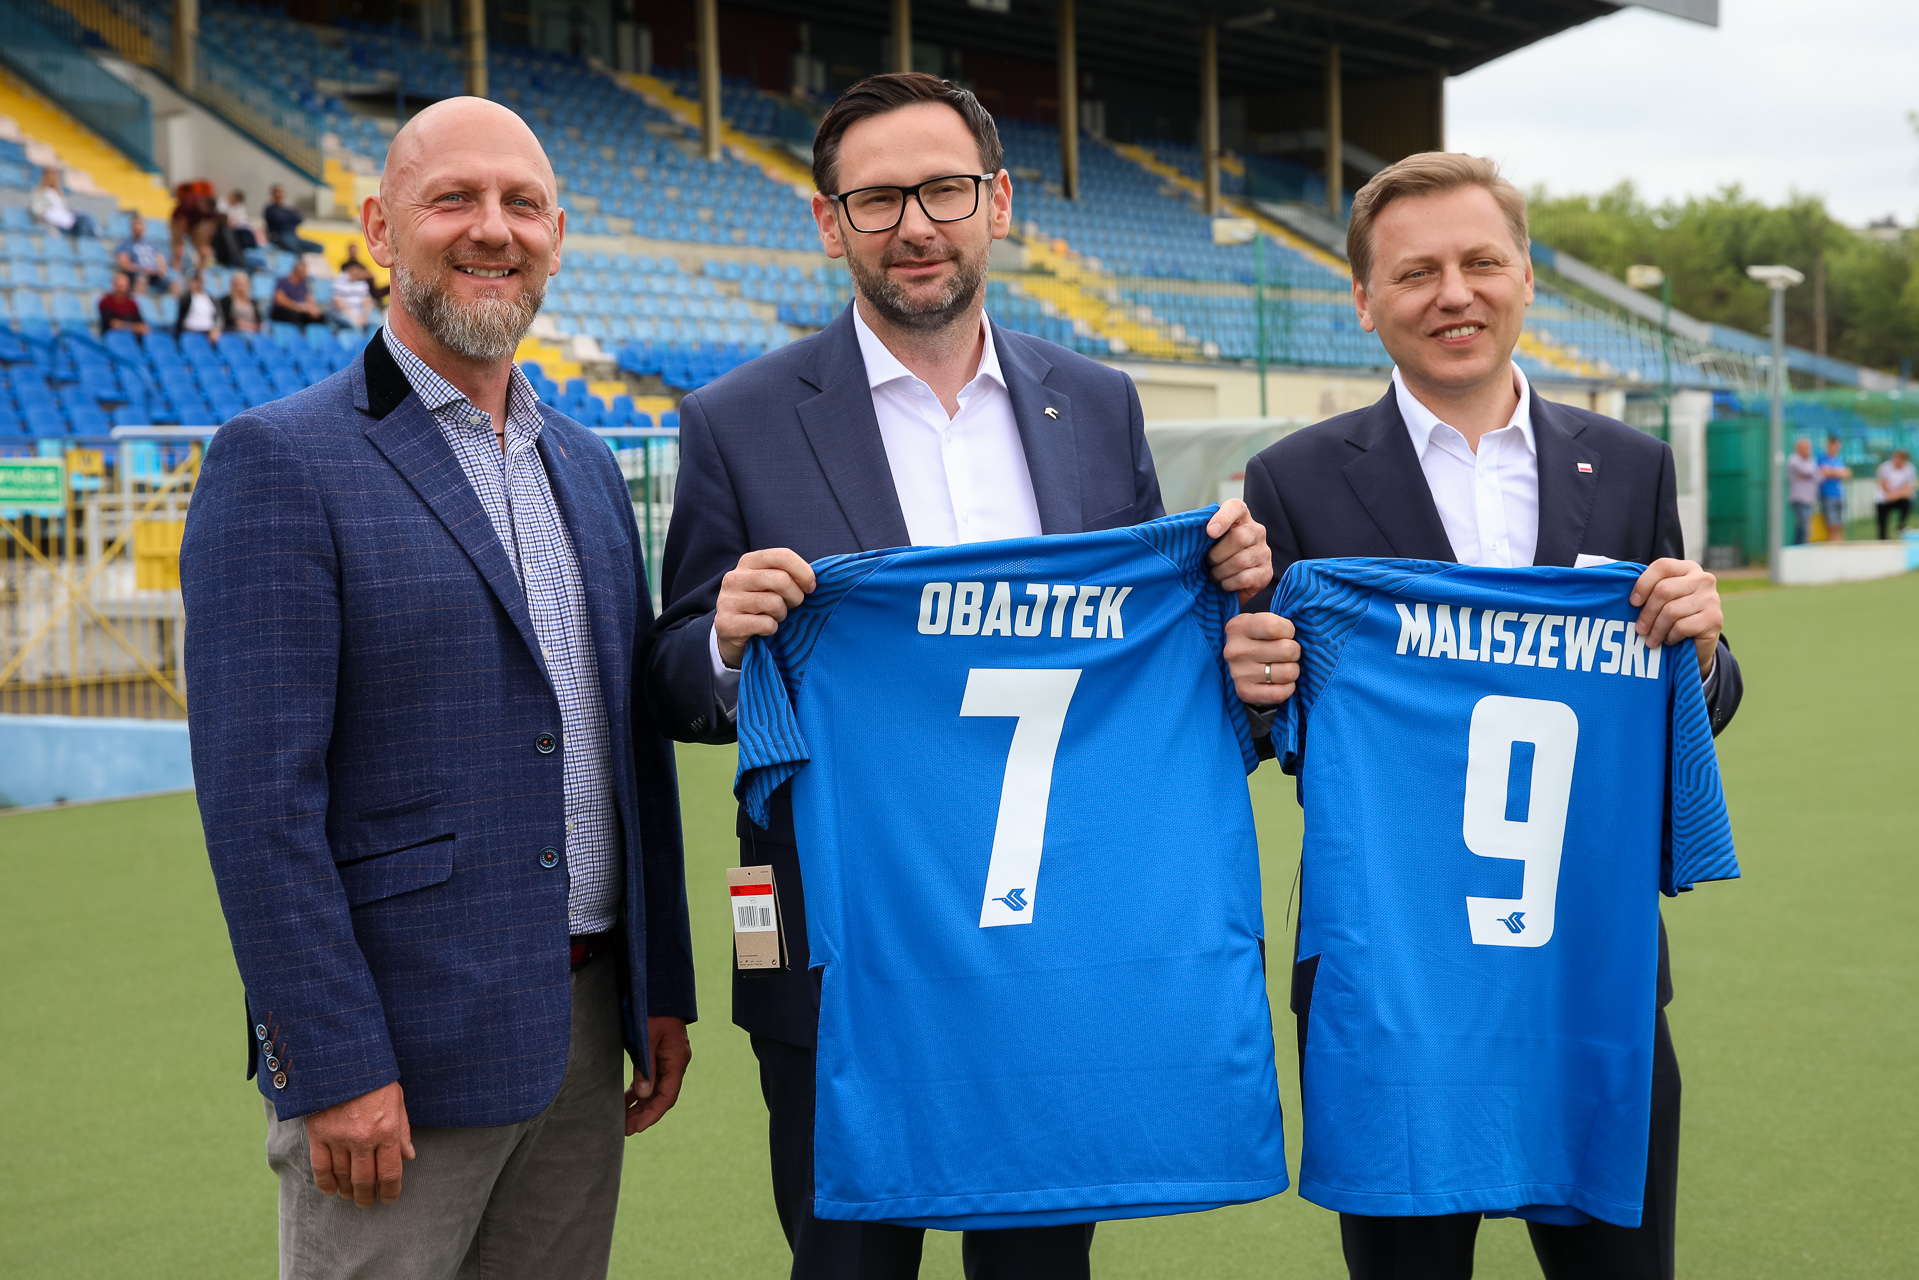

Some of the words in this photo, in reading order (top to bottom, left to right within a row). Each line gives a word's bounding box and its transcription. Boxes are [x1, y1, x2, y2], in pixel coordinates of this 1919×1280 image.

[917, 581, 1133, 639] OBAJTEK
[1394, 603, 1662, 680] MALISZEWSKI
[959, 668, 1083, 928] 7
[1462, 694, 1579, 948] 9
